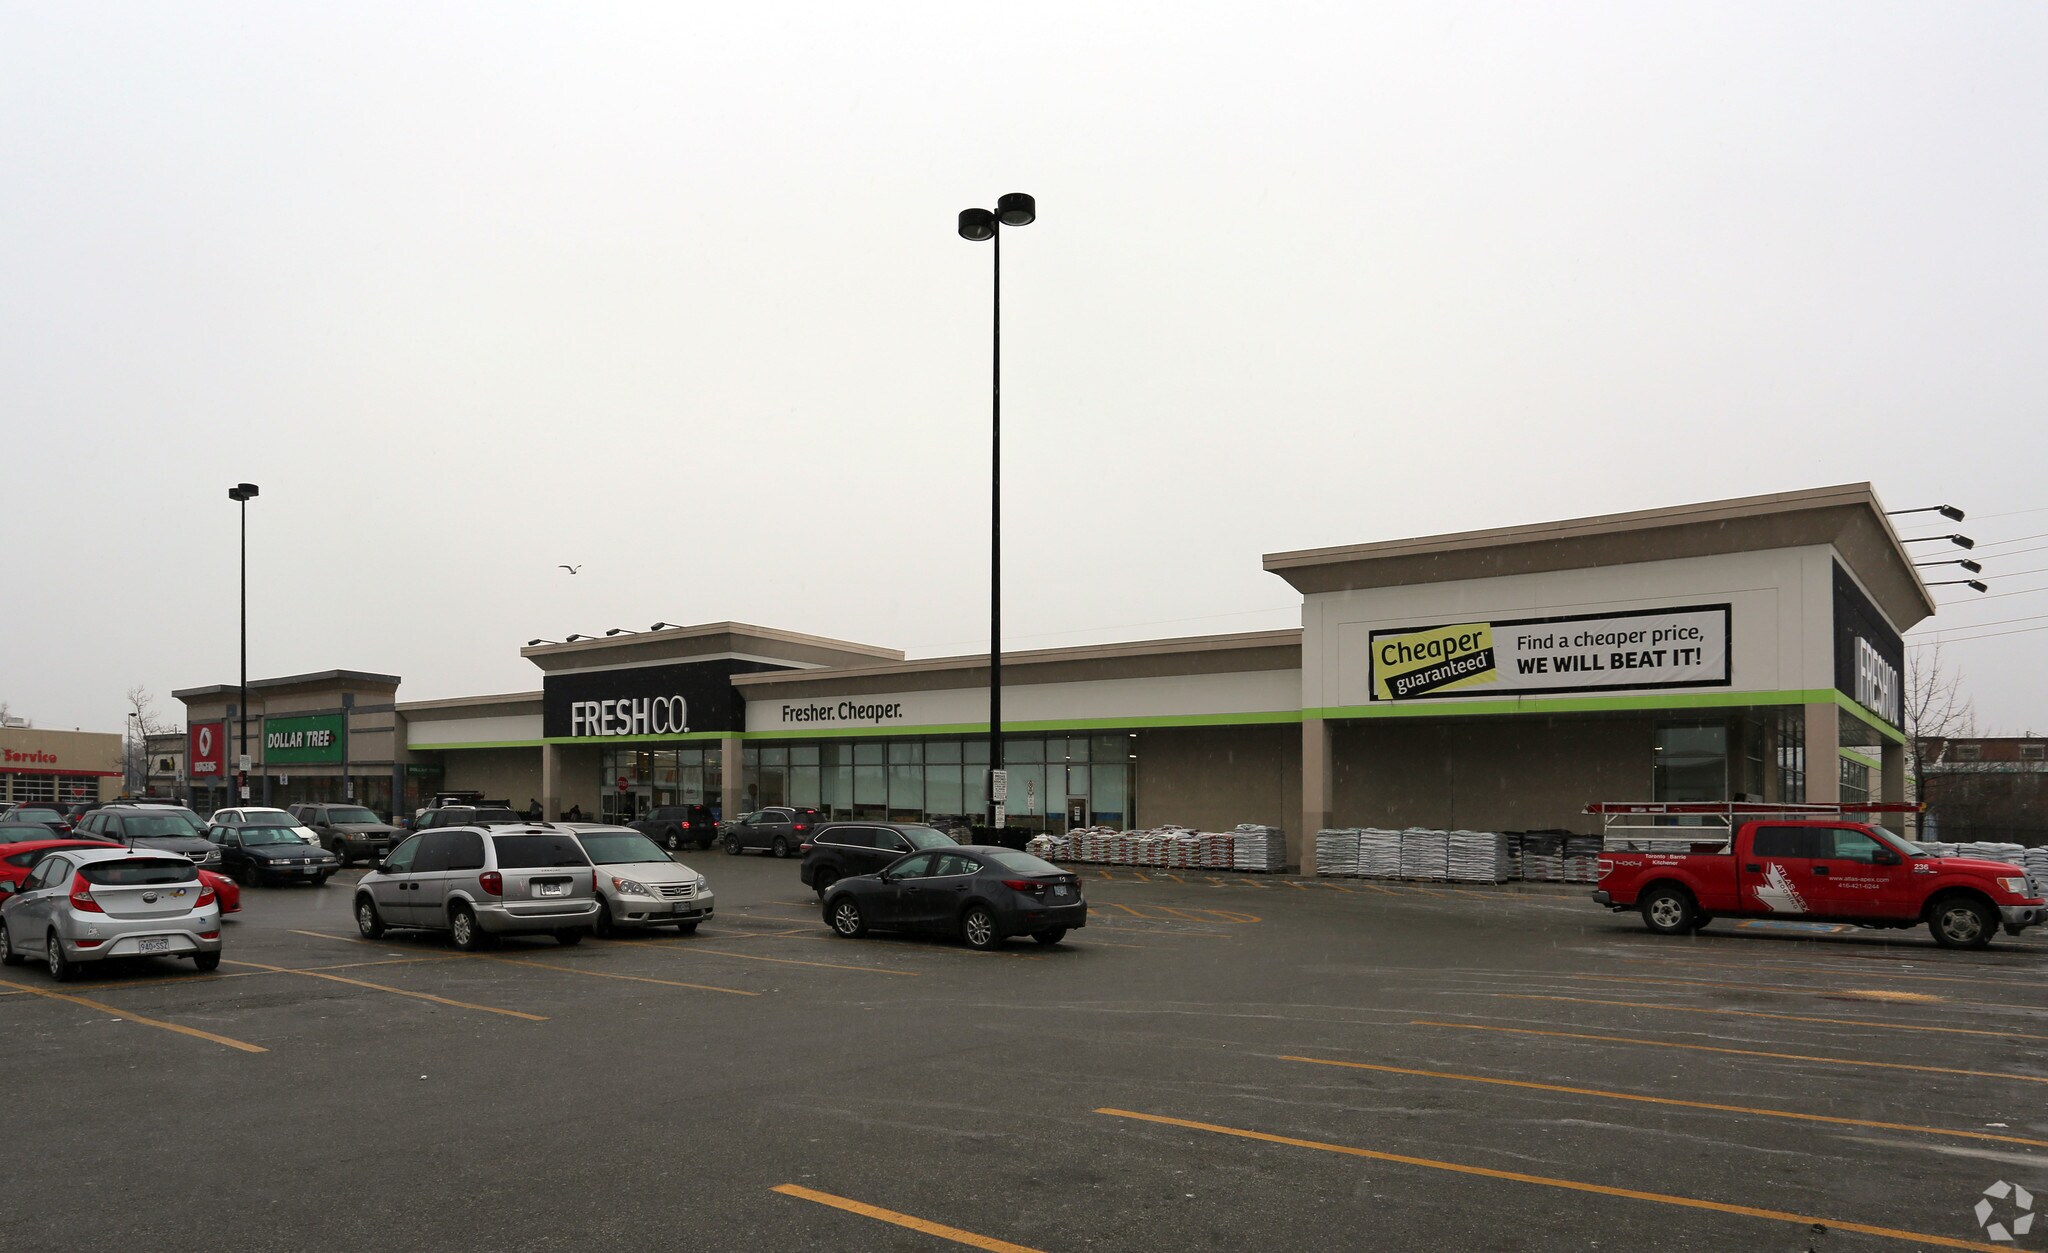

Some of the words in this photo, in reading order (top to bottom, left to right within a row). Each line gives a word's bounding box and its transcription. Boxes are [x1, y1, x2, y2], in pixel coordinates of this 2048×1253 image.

[1381, 631, 1482, 666] Cheaper
[1517, 633, 1553, 651] Find
[1558, 636, 1569, 648] a
[1573, 631, 1647, 649] cheaper
[1651, 624, 1704, 646] price,
[1517, 657, 1548, 675] WE
[1552, 654, 1605, 673] WILL
[1610, 650, 1667, 670] BEAT
[1673, 647, 1702, 666] IT!
[782, 703, 835, 722] Fresher.
[838, 701, 902, 724] Cheaper.
[267, 732, 303, 749] DOLLAR
[306, 729, 331, 747] TREE
[4, 748, 57, 763] Service
